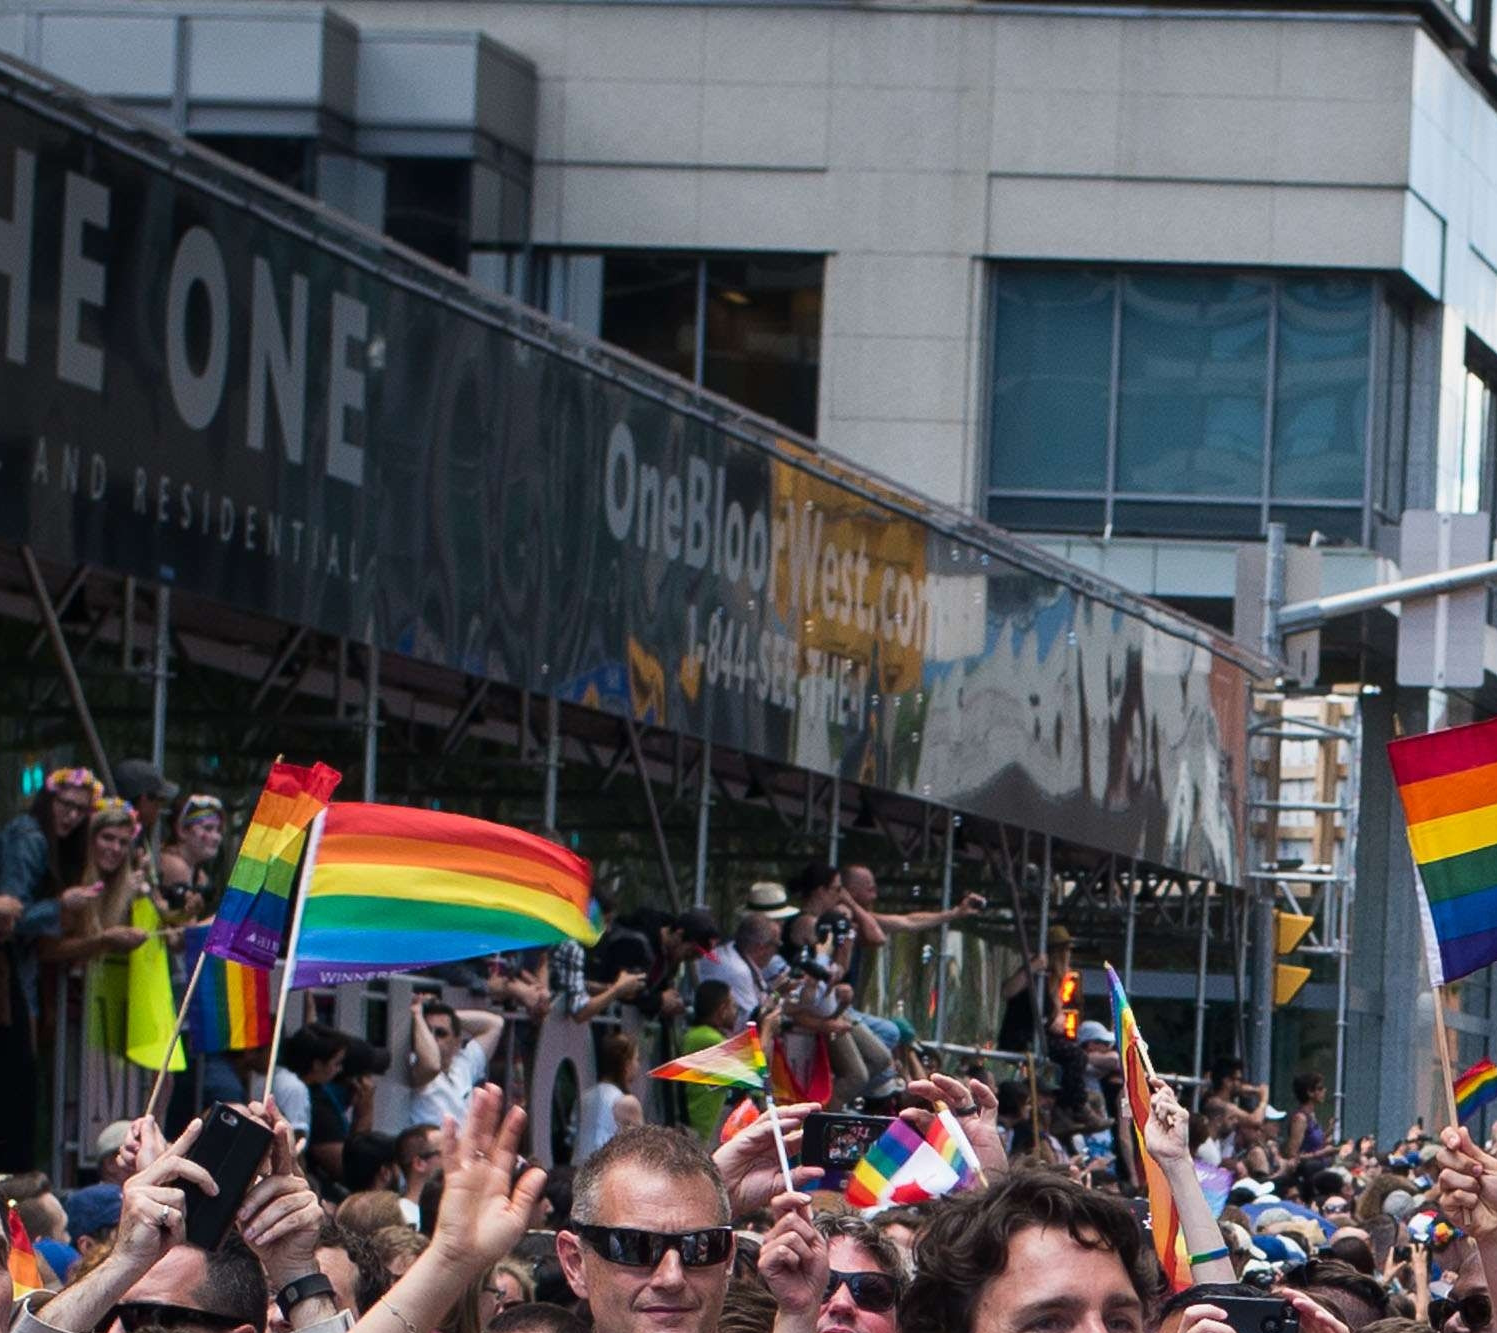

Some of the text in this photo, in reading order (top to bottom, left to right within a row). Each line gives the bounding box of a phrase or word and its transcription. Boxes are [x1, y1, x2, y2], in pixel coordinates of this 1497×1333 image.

[166, 224, 369, 488] ONE
[32, 437, 107, 501] AND
[134, 466, 360, 584] RESIDENTIAL
